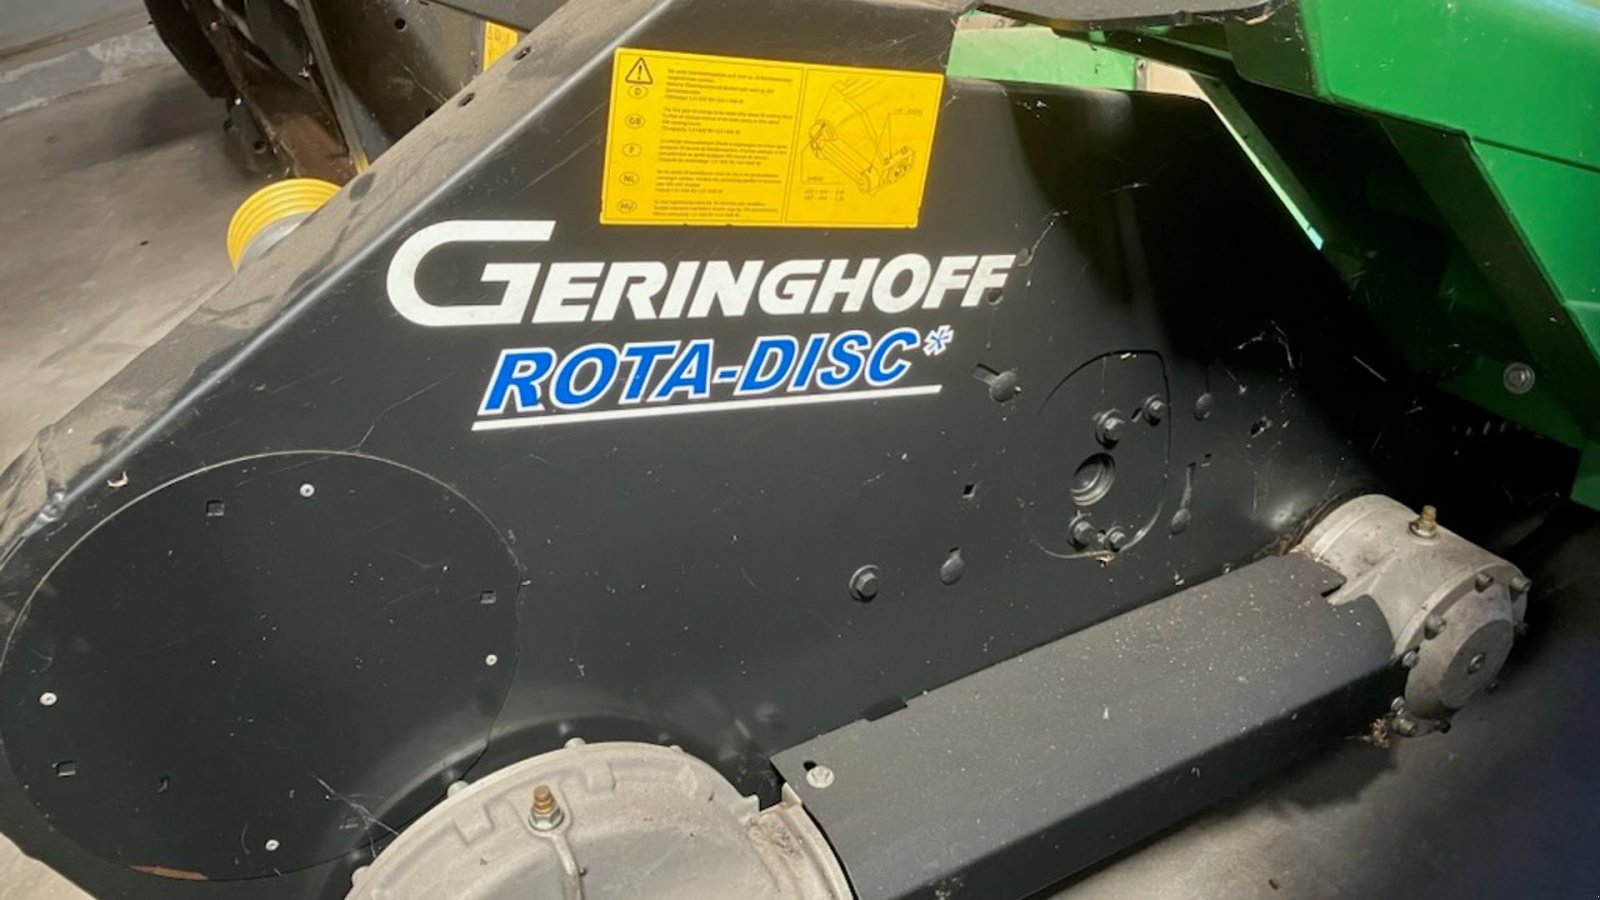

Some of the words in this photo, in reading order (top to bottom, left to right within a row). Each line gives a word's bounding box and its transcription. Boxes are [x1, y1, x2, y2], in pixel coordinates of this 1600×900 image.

[628, 116, 642, 126] GB
[623, 174, 635, 183] NL
[386, 220, 1016, 328] GERINGHOFF
